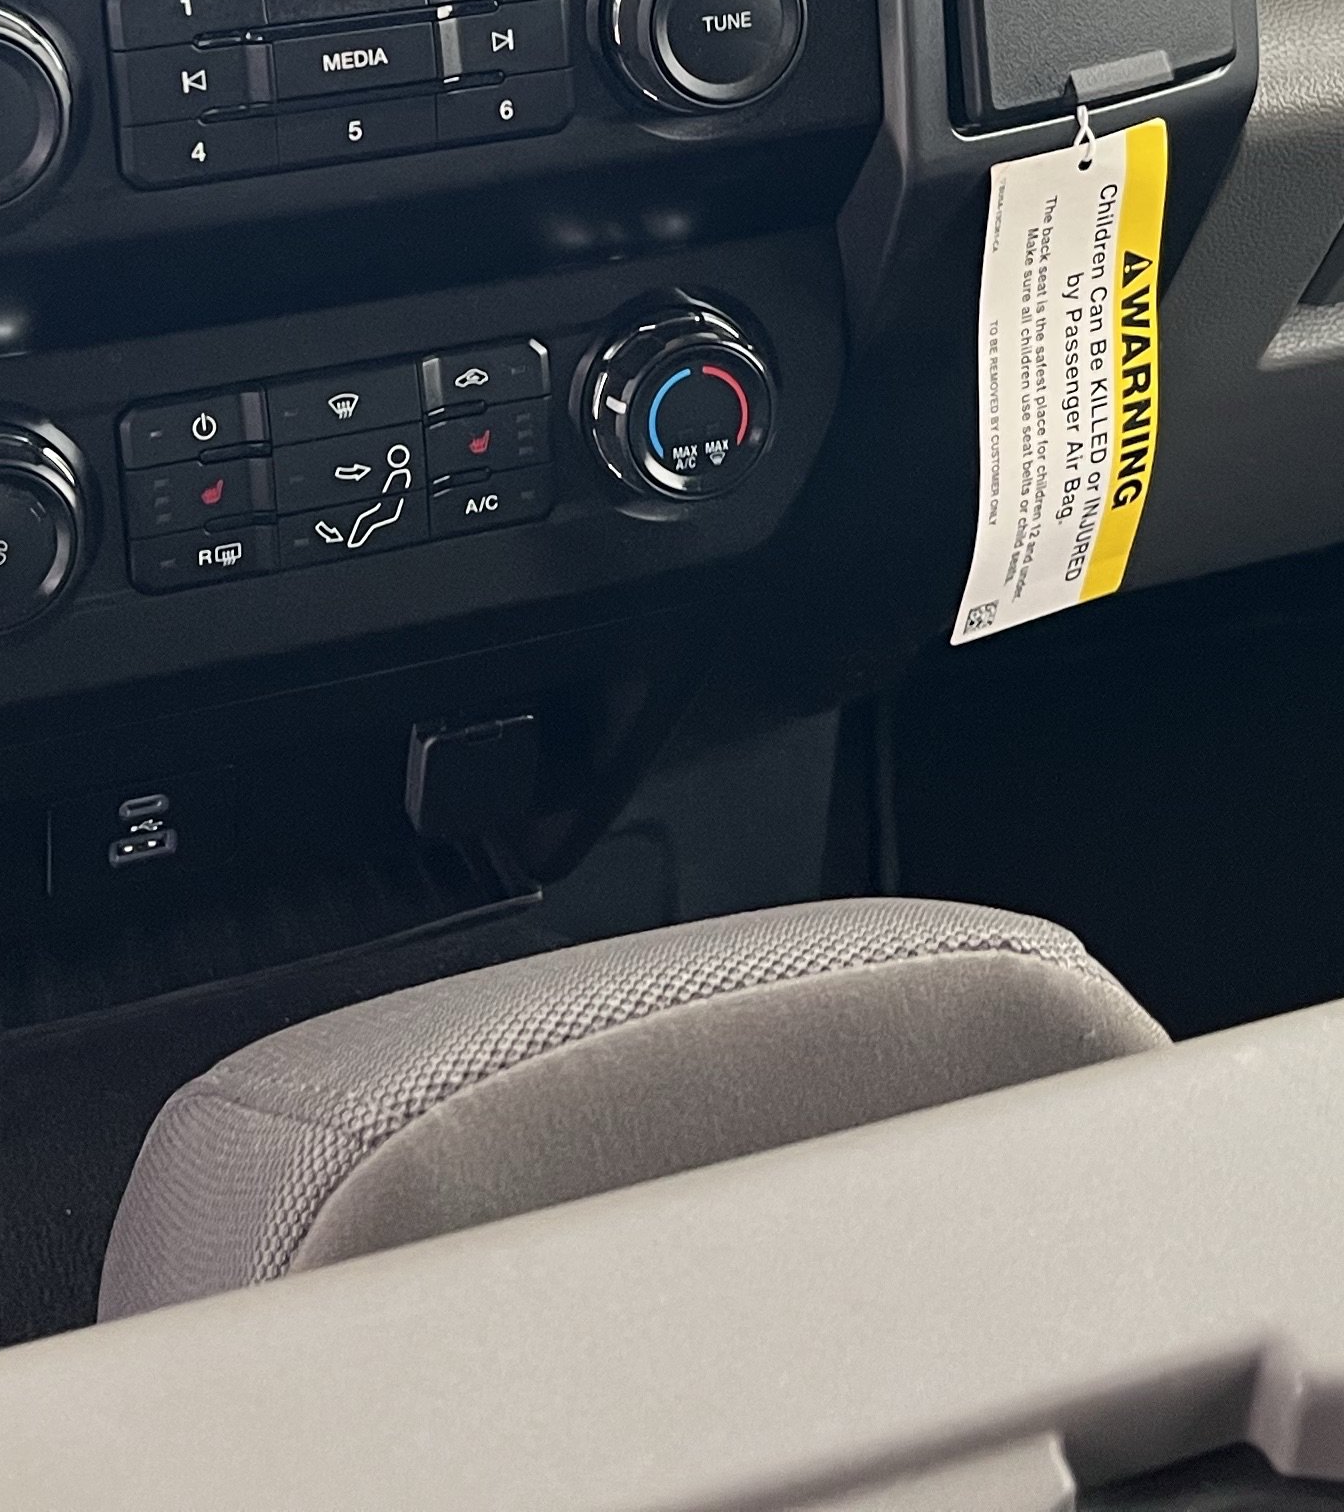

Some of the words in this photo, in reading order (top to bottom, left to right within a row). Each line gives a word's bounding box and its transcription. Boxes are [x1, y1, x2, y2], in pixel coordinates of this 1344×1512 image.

[701, 11, 753, 33] TUNE
[322, 46, 389, 73] MEDIA
[498, 99, 515, 122] 6
[347, 119, 363, 142] 5
[190, 141, 207, 163] 4
[1044, 194, 1058, 224] The
[1038, 226, 1055, 263] back
[1091, 183, 1118, 280] Children
[1025, 226, 1040, 267] Make
[1022, 270, 1034, 304] sure
[1035, 265, 1049, 298] seat
[1062, 272, 1085, 300] by
[1020, 306, 1033, 324] all
[1035, 300, 1048, 314] is
[1089, 287, 1108, 333] Can
[989, 319, 999, 336] TO
[1035, 314, 1048, 341] the
[989, 339, 999, 354] BE
[1019, 326, 1033, 395] children
[1089, 339, 1107, 371] Be
[1035, 344, 1048, 389] safest
[1061, 308, 1083, 433] Passenger
[989, 357, 1000, 414] REMOVED
[1112, 284, 1153, 510] WARNING
[1021, 395, 1031, 422] use
[1033, 396, 1048, 436] place
[1089, 377, 1108, 464] KILLED
[989, 416, 1000, 431] BY
[672, 444, 698, 461] MAX
[705, 439, 729, 454] MAX
[1022, 424, 1034, 459] seat
[1036, 439, 1049, 461] for
[1065, 441, 1084, 471] Air
[676, 455, 697, 471] A/C
[989, 434, 1001, 497] CUSTOMER
[1020, 460, 1034, 497] belts
[1033, 463, 1048, 522] children
[1086, 471, 1101, 492] or
[464, 494, 499, 516] A/C
[987, 498, 1000, 527] ONLY
[1018, 499, 1030, 516] or
[1055, 479, 1081, 525] Bag.
[1013, 516, 1027, 550] child
[1028, 523, 1042, 539] 12
[1065, 496, 1101, 582] INJURED
[198, 549, 212, 566] R
[1021, 541, 1036, 567] and
